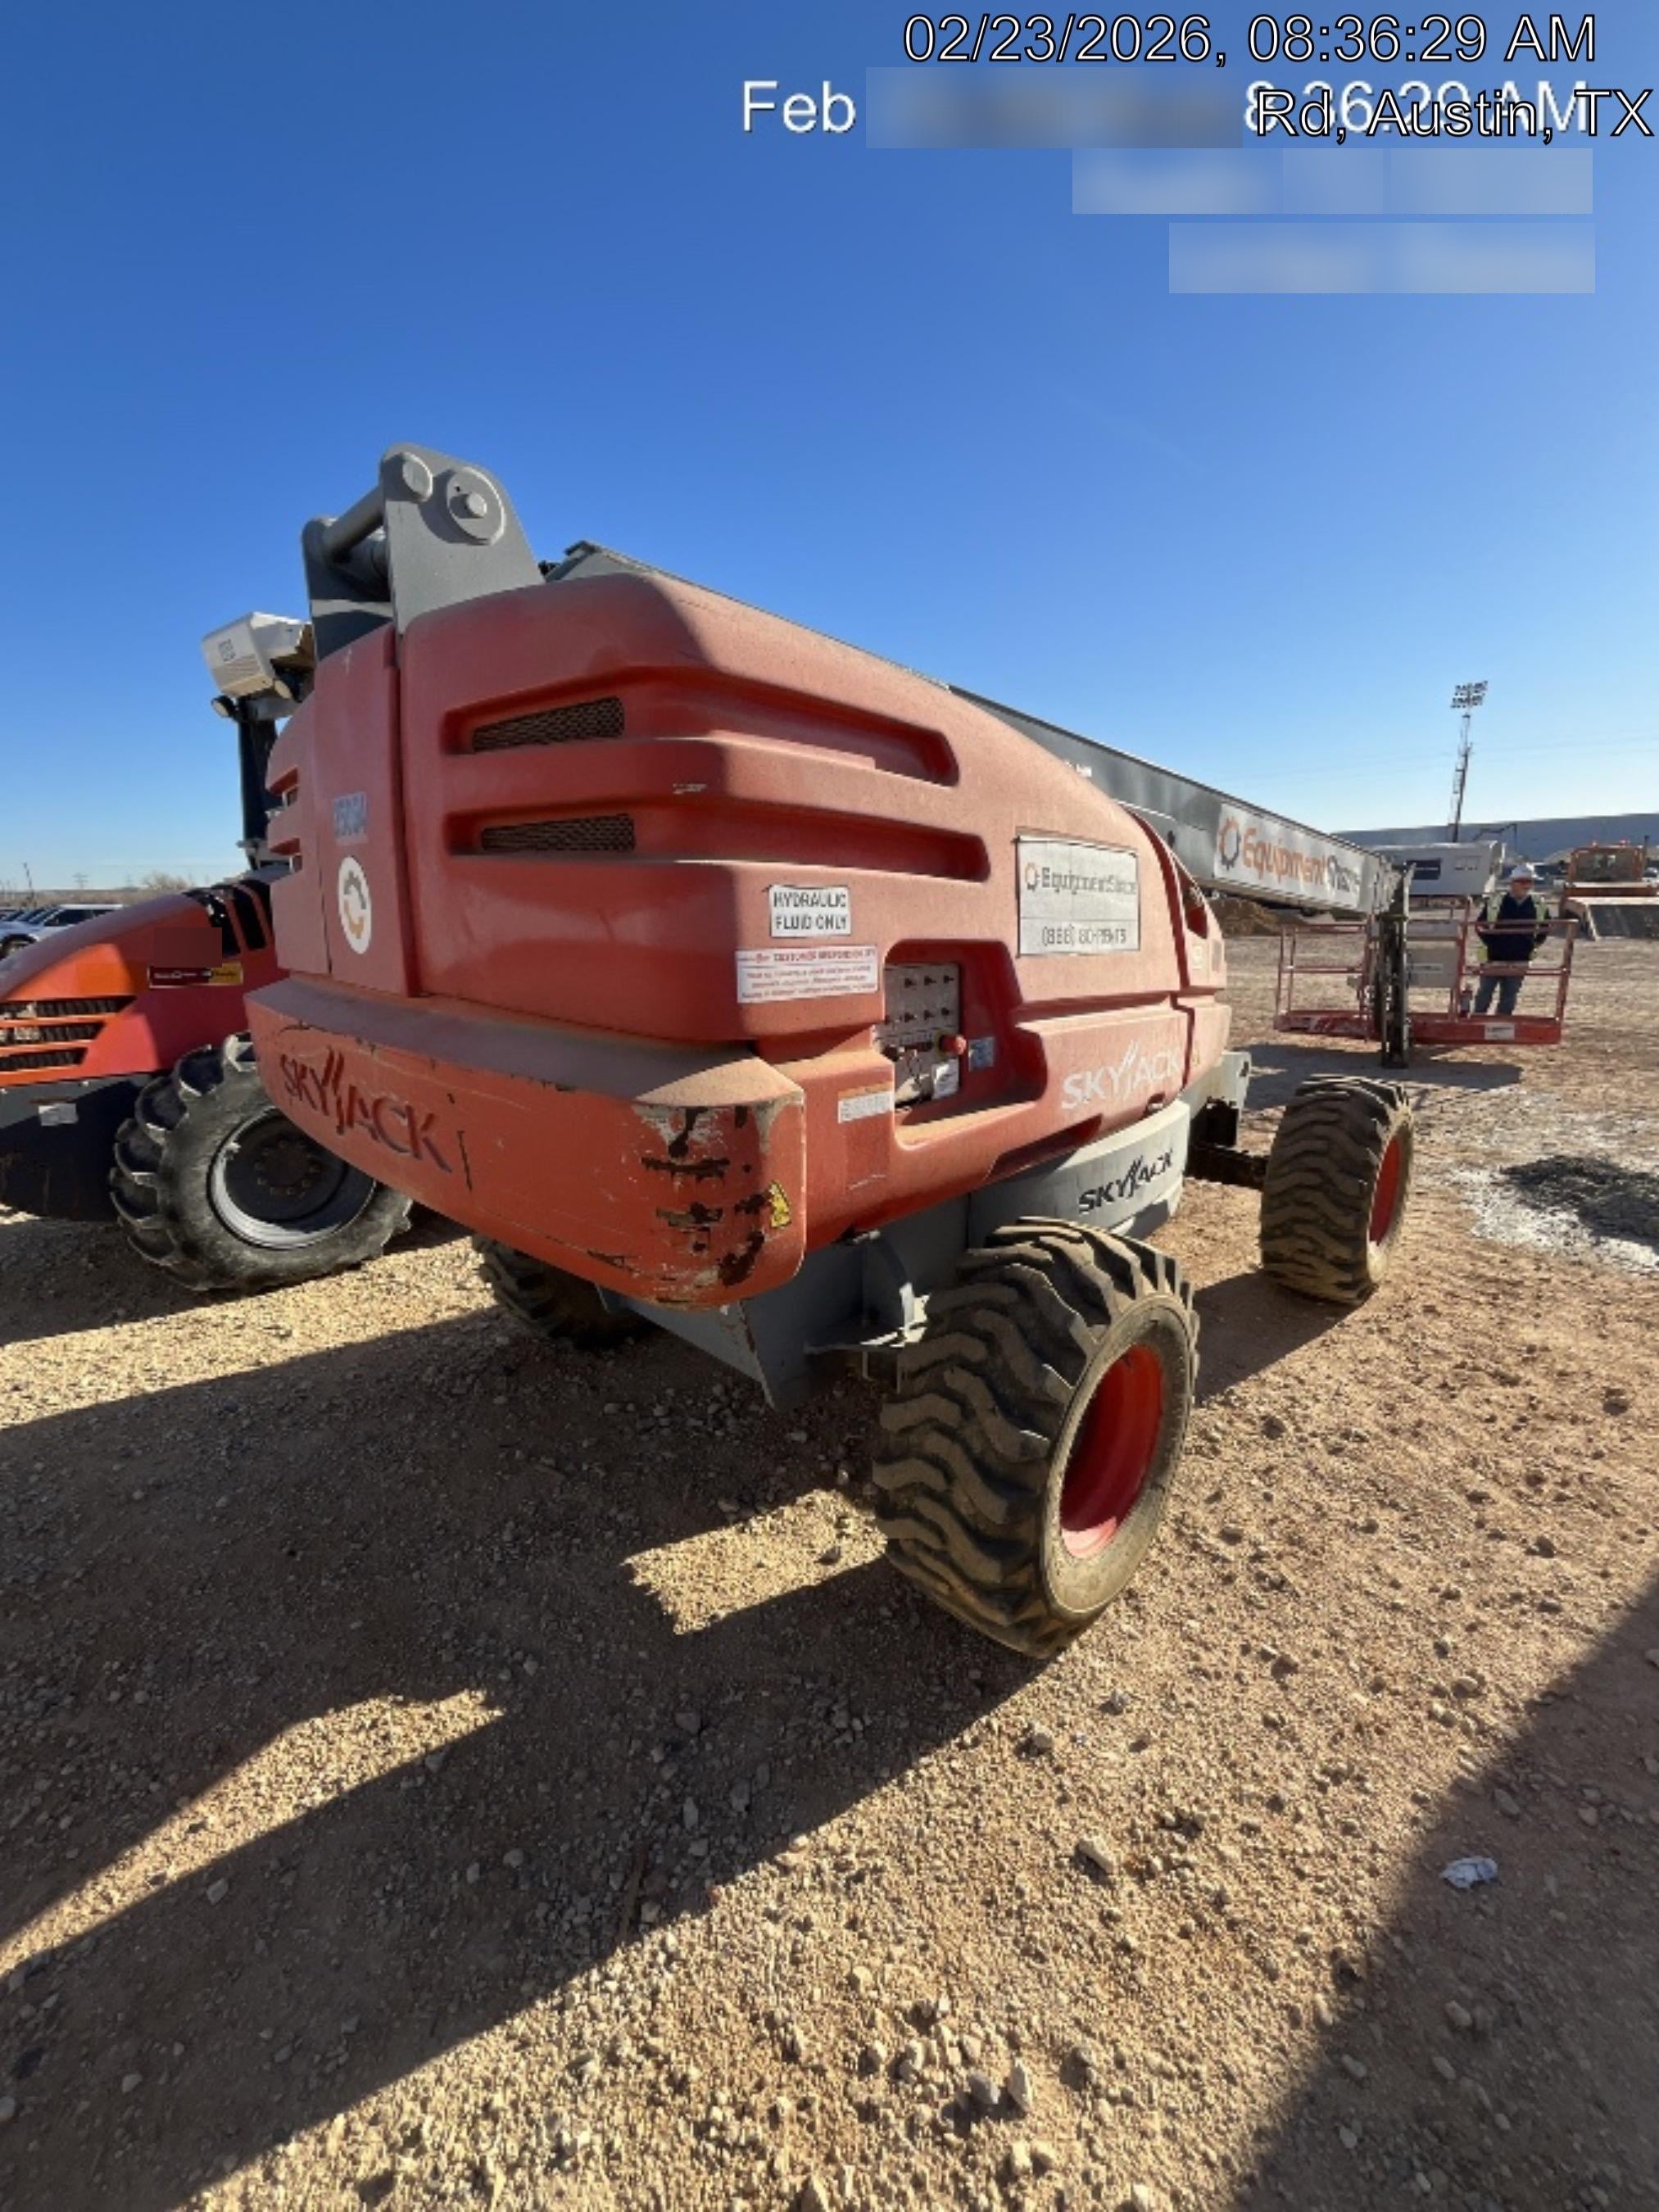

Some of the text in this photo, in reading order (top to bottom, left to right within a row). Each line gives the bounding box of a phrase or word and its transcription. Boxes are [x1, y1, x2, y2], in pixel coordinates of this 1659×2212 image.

[773, 891, 846, 908] HYDRAULIC
[775, 913, 847, 931] FLUID ONLY
[280, 1044, 452, 1174] SKYJACK
[1077, 1147, 1174, 1216] SKYJACK
